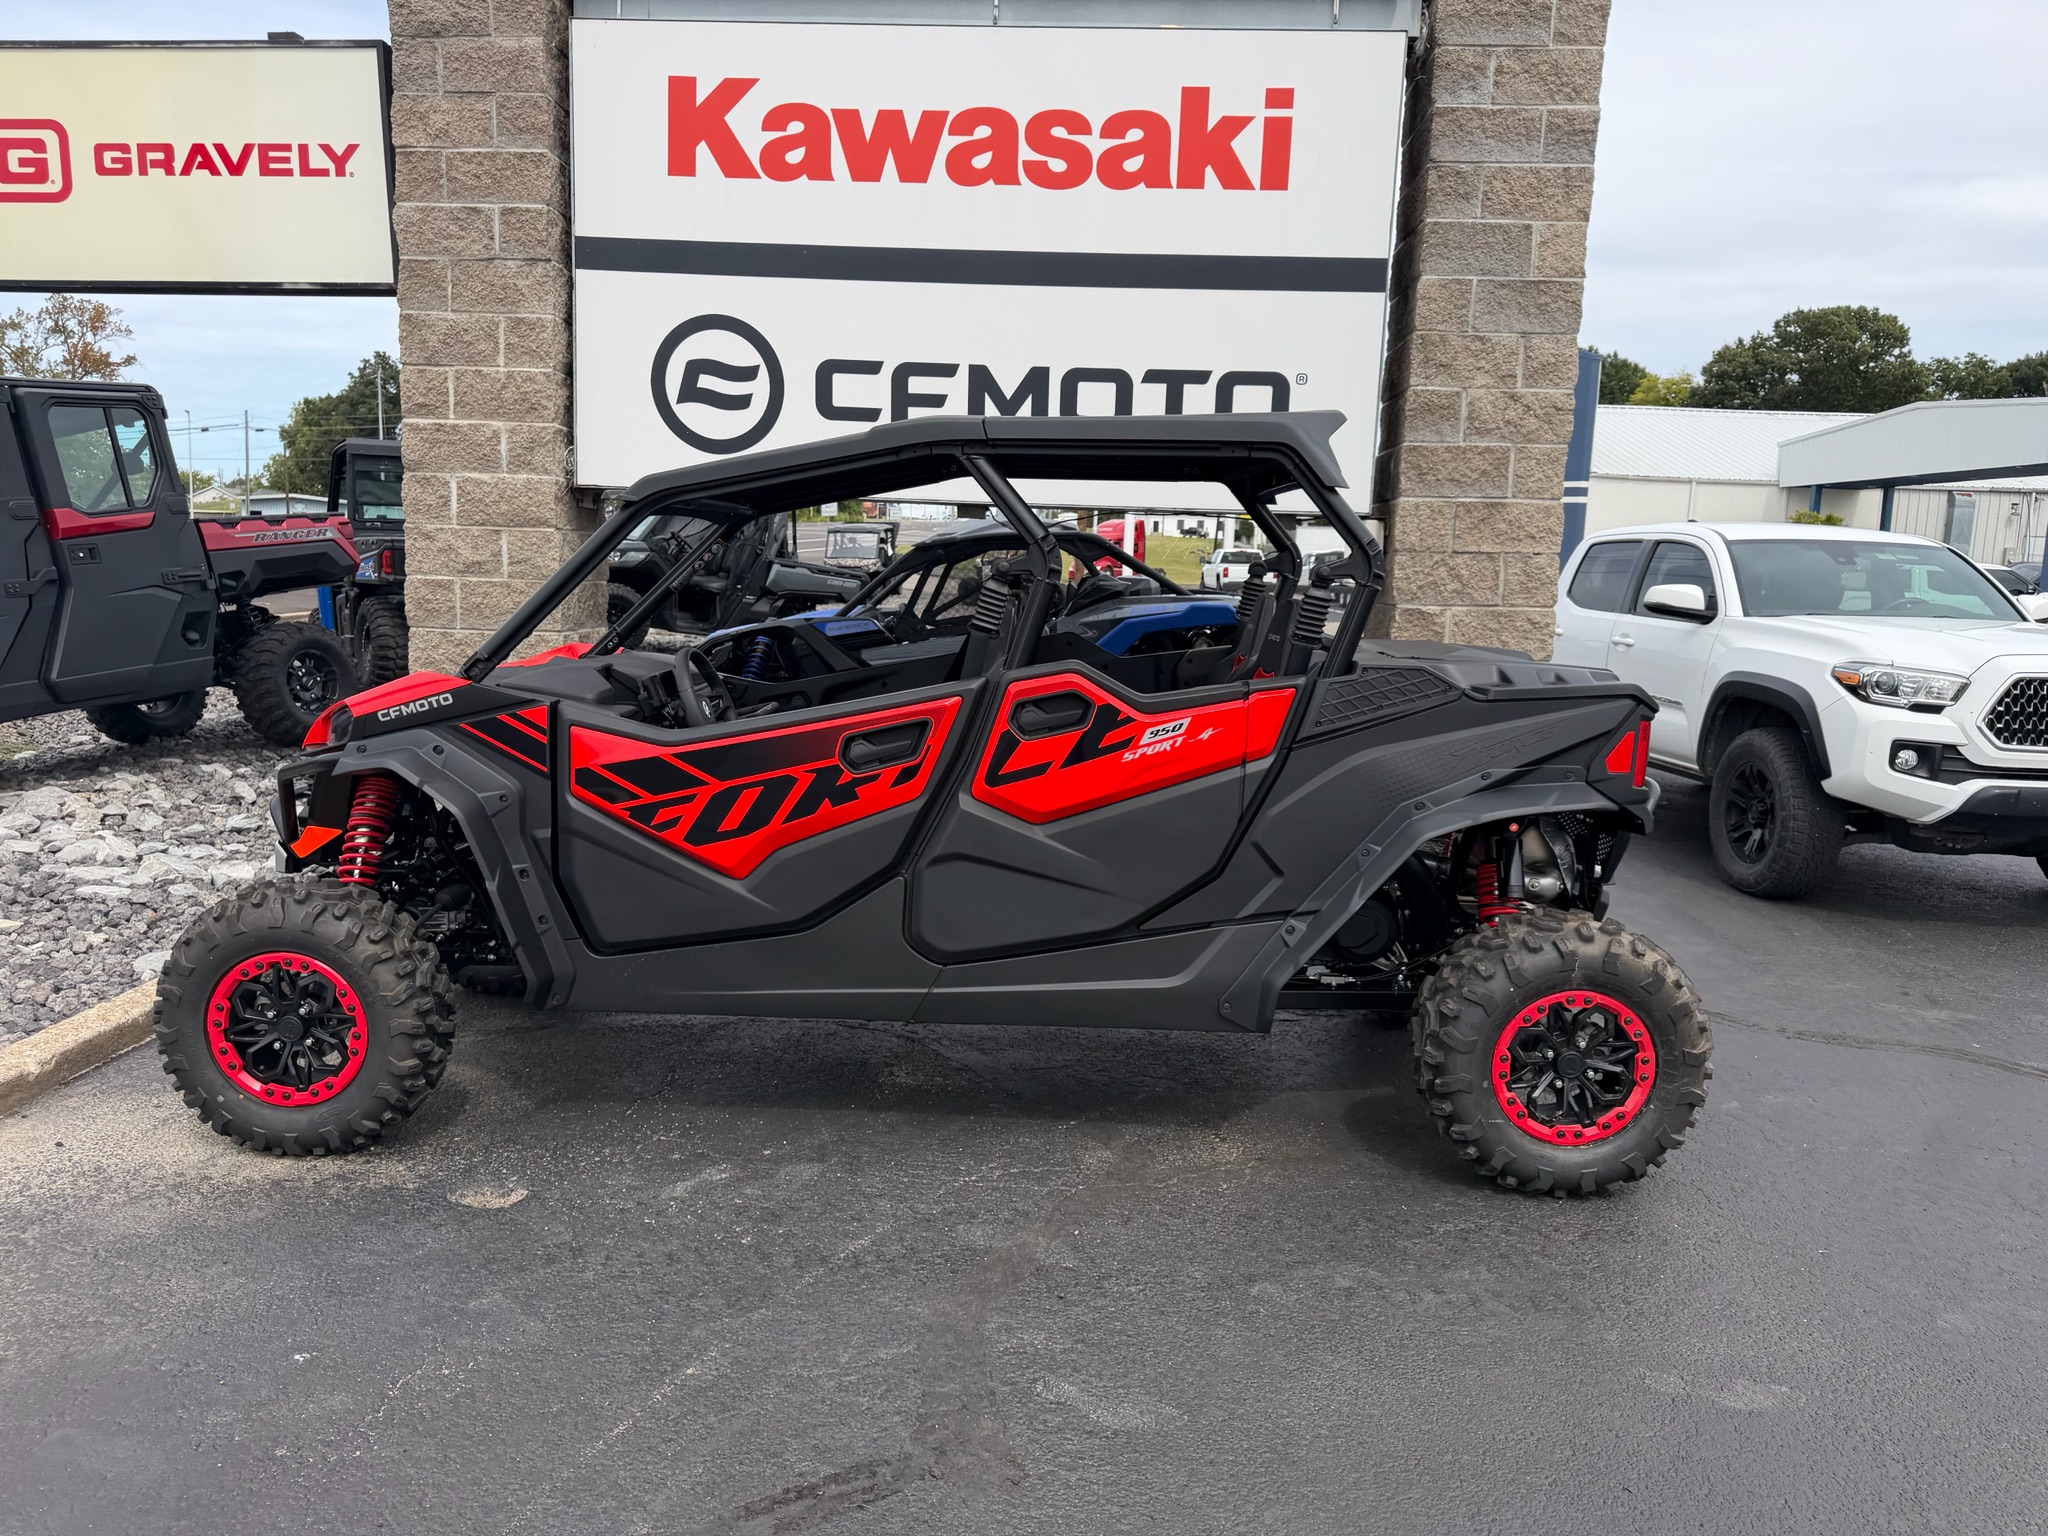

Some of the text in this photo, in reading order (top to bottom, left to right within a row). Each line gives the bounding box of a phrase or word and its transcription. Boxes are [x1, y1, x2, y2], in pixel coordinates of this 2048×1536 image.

[667, 74, 1295, 191] Kawasaki
[94, 143, 360, 177] GRAVELY
[253, 528, 329, 543] RANGER
[377, 693, 453, 722] CFMOTO
[1148, 722, 1184, 740] 950
[1121, 736, 1187, 763] SPORT
